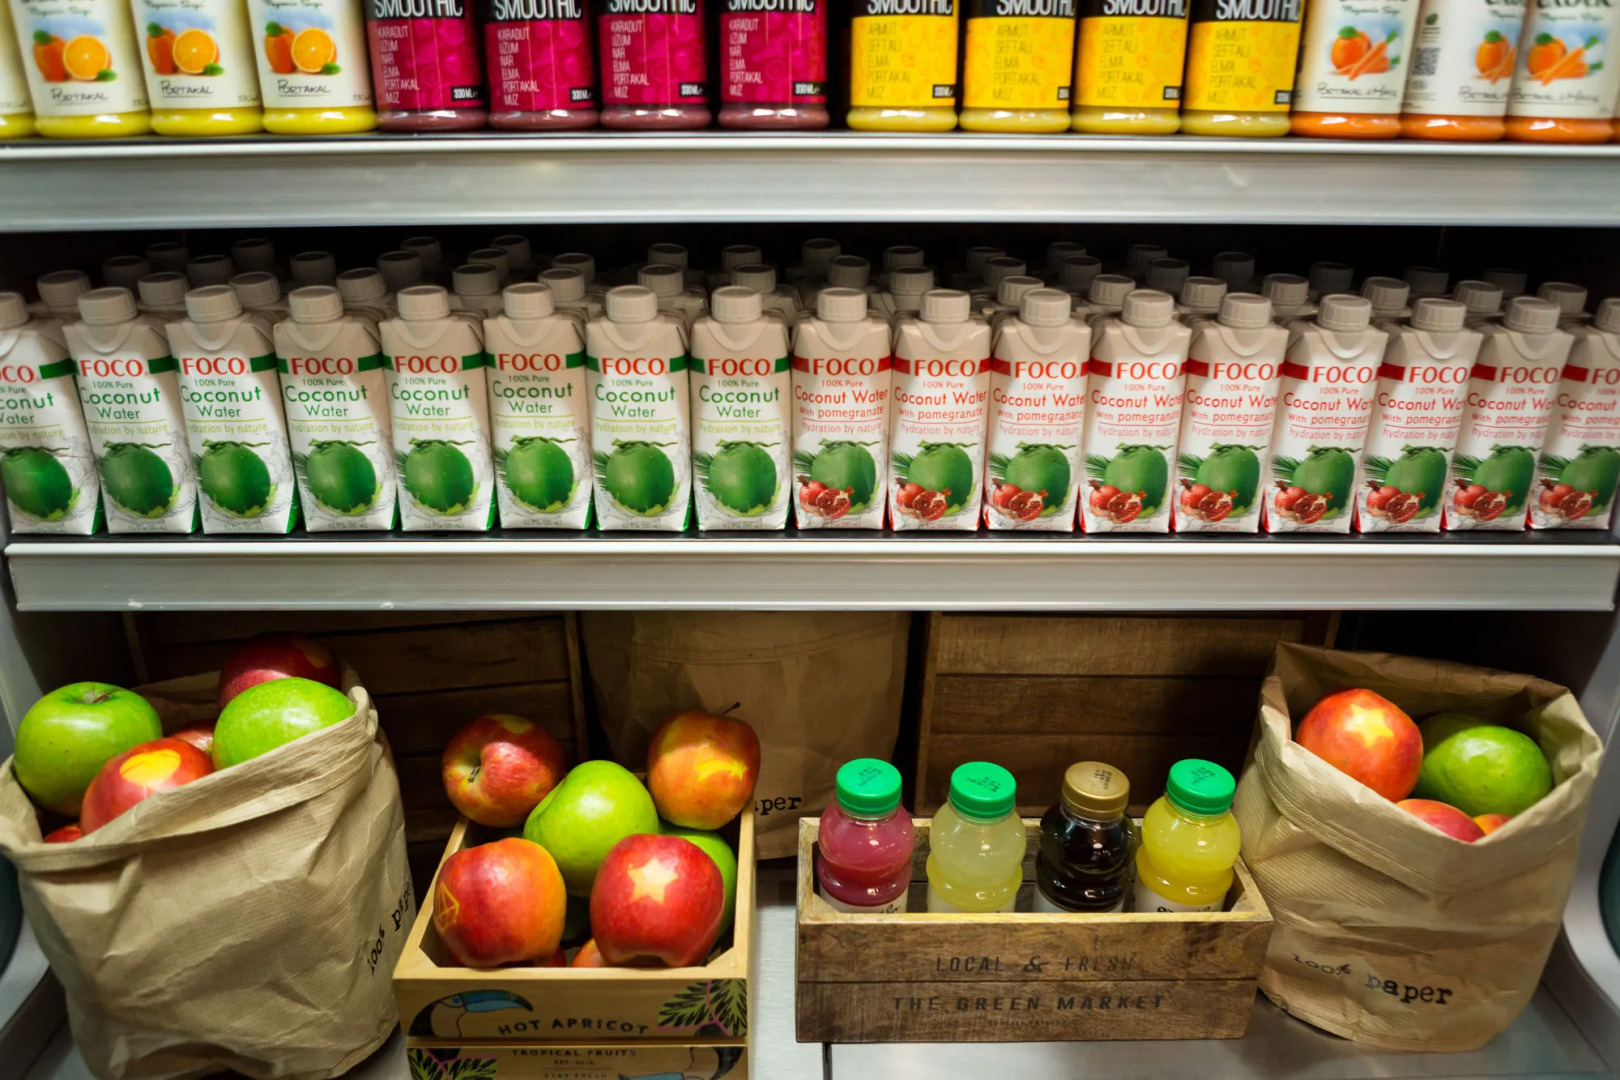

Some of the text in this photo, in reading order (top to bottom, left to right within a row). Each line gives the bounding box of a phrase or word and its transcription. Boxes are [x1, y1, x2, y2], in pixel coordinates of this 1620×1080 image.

[80, 359, 143, 377] FOCO
[182, 357, 245, 375] FOCO
[291, 357, 353, 376] FOCO
[395, 356, 457, 374] FOCO
[499, 354, 561, 371] FOCO
[602, 358, 665, 376] FOCO
[709, 358, 771, 376] FOCO
[813, 358, 875, 376] FOCO
[914, 359, 976, 377] FOCO
[1015, 361, 1077, 379] FOCO
[1117, 362, 1177, 380] FOCO
[0, 365, 35, 383] CO
[1213, 363, 1274, 381] FOCO
[1313, 366, 1373, 383] FOCO
[1409, 366, 1467, 383] FOCO
[1500, 367, 1559, 384] FOCO
[1591, 368, 1620, 384] FO
[116, 381, 134, 389] Pure
[391, 383, 469, 401] Coconut
[493, 381, 573, 398] Coconut
[611, 379, 633, 387] 100%
[0, 393, 54, 410] conut
[80, 387, 160, 405] Coconut
[181, 385, 261, 402] Coconut
[285, 385, 367, 402] Coconut
[596, 384, 675, 402] Coconut
[699, 385, 779, 402] Coconut
[795, 385, 889, 404] Coconut Water
[895, 387, 947, 405] Coconut
[993, 388, 1046, 407] Coconut
[1092, 390, 1147, 408] Coconut
[1187, 390, 1242, 408] Coconut
[1284, 392, 1340, 411] Coconut
[1378, 393, 1437, 411] Coconut
[1468, 393, 1527, 411] Coconut
[1557, 393, 1616, 411] Coconut
[96, 407, 140, 419] Water
[197, 405, 241, 418] Water
[304, 404, 349, 417] Water
[405, 403, 450, 416] Water
[508, 401, 553, 413] Water
[611, 405, 656, 417] Water
[717, 406, 760, 418] Water
[818, 406, 884, 420] pomegranate
[936, 957, 1003, 973] LOCAL
[1023, 955, 1060, 973] &
[1291, 953, 1453, 1004] 100% paper
[894, 995, 1163, 1011] THE GREEN MARKET
[498, 1018, 649, 1036] HOT APRICOT
[512, 1049, 637, 1057] TROPICAL FRUITS
